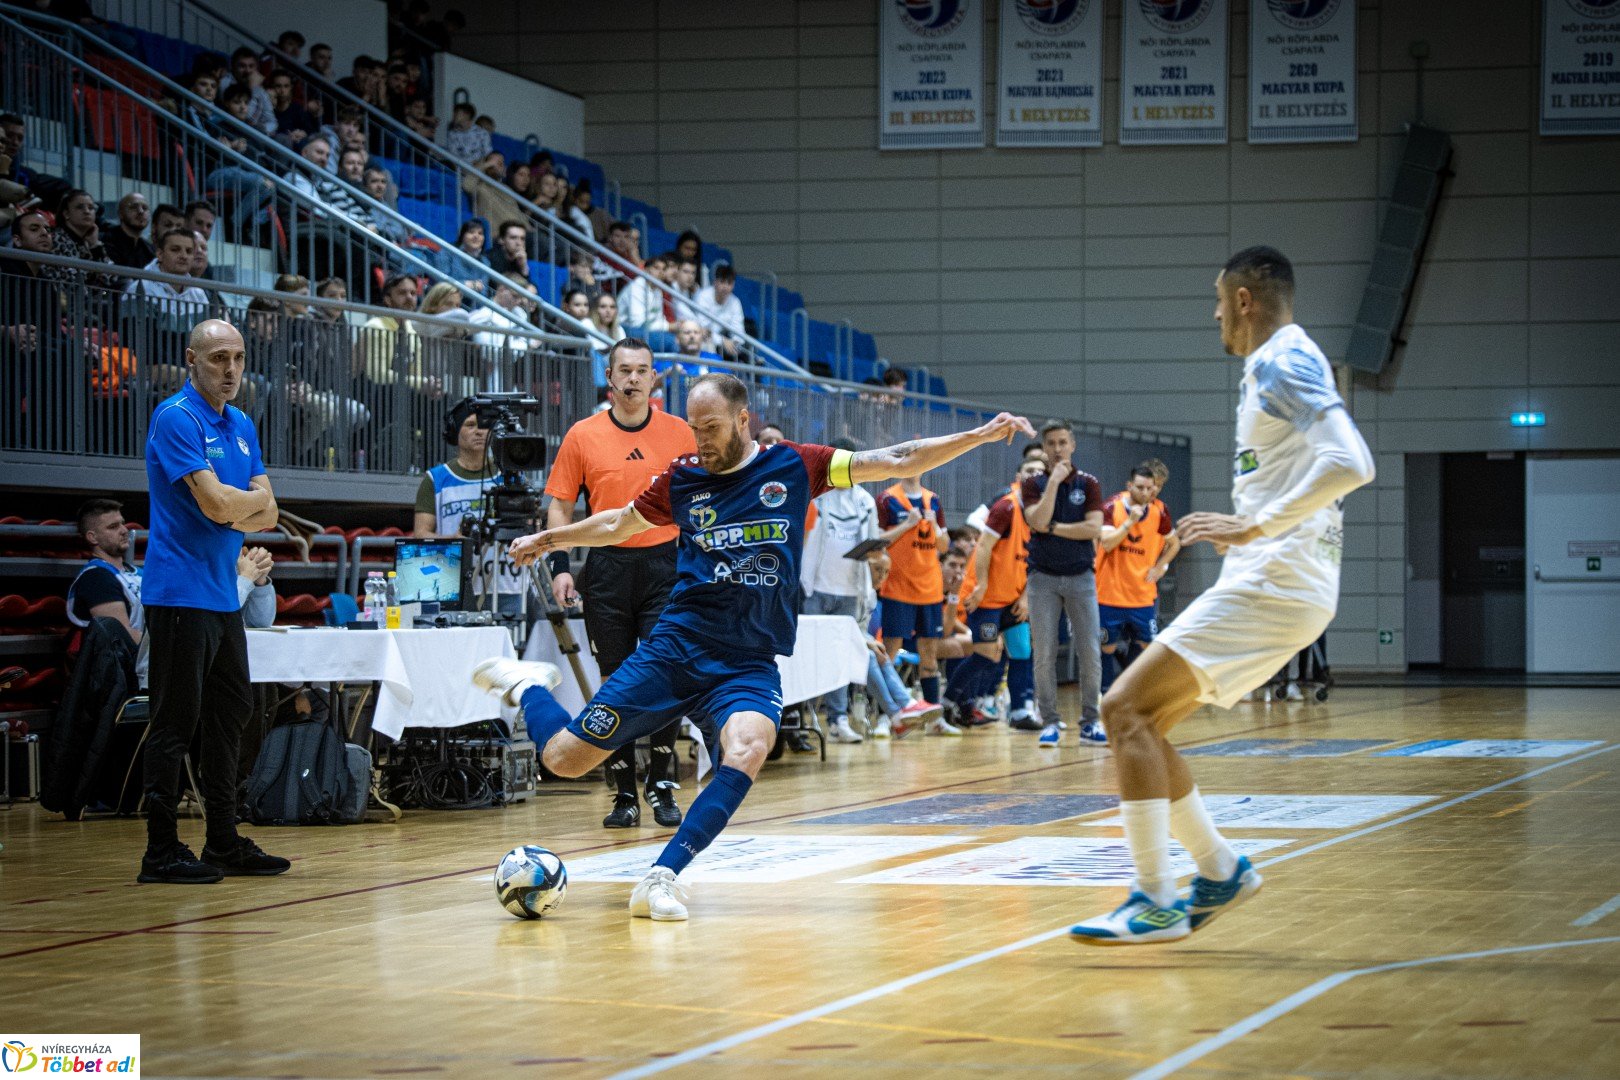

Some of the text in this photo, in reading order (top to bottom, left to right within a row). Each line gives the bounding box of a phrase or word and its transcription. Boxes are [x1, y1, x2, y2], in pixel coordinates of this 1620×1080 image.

[1583, 52, 1614, 66] 2019
[1037, 68, 1064, 82] 2021
[1161, 66, 1188, 79] 2021
[1290, 63, 1318, 77] 2020
[1551, 72, 1590, 84] MAGYAR
[1008, 86, 1043, 97] MAGYAR
[1134, 84, 1215, 97] MAGYAR KUPA
[1261, 81, 1345, 95] MAGYAR KUPA
[893, 89, 972, 101] MAGYAR KUPA
[1145, 103, 1215, 119] HELYEZÉS
[1277, 100, 1347, 117] HELYEZÉS
[691, 492, 711, 503] JAKO
[593, 709, 615, 726] 99.4
[589, 723, 602, 734] FM
